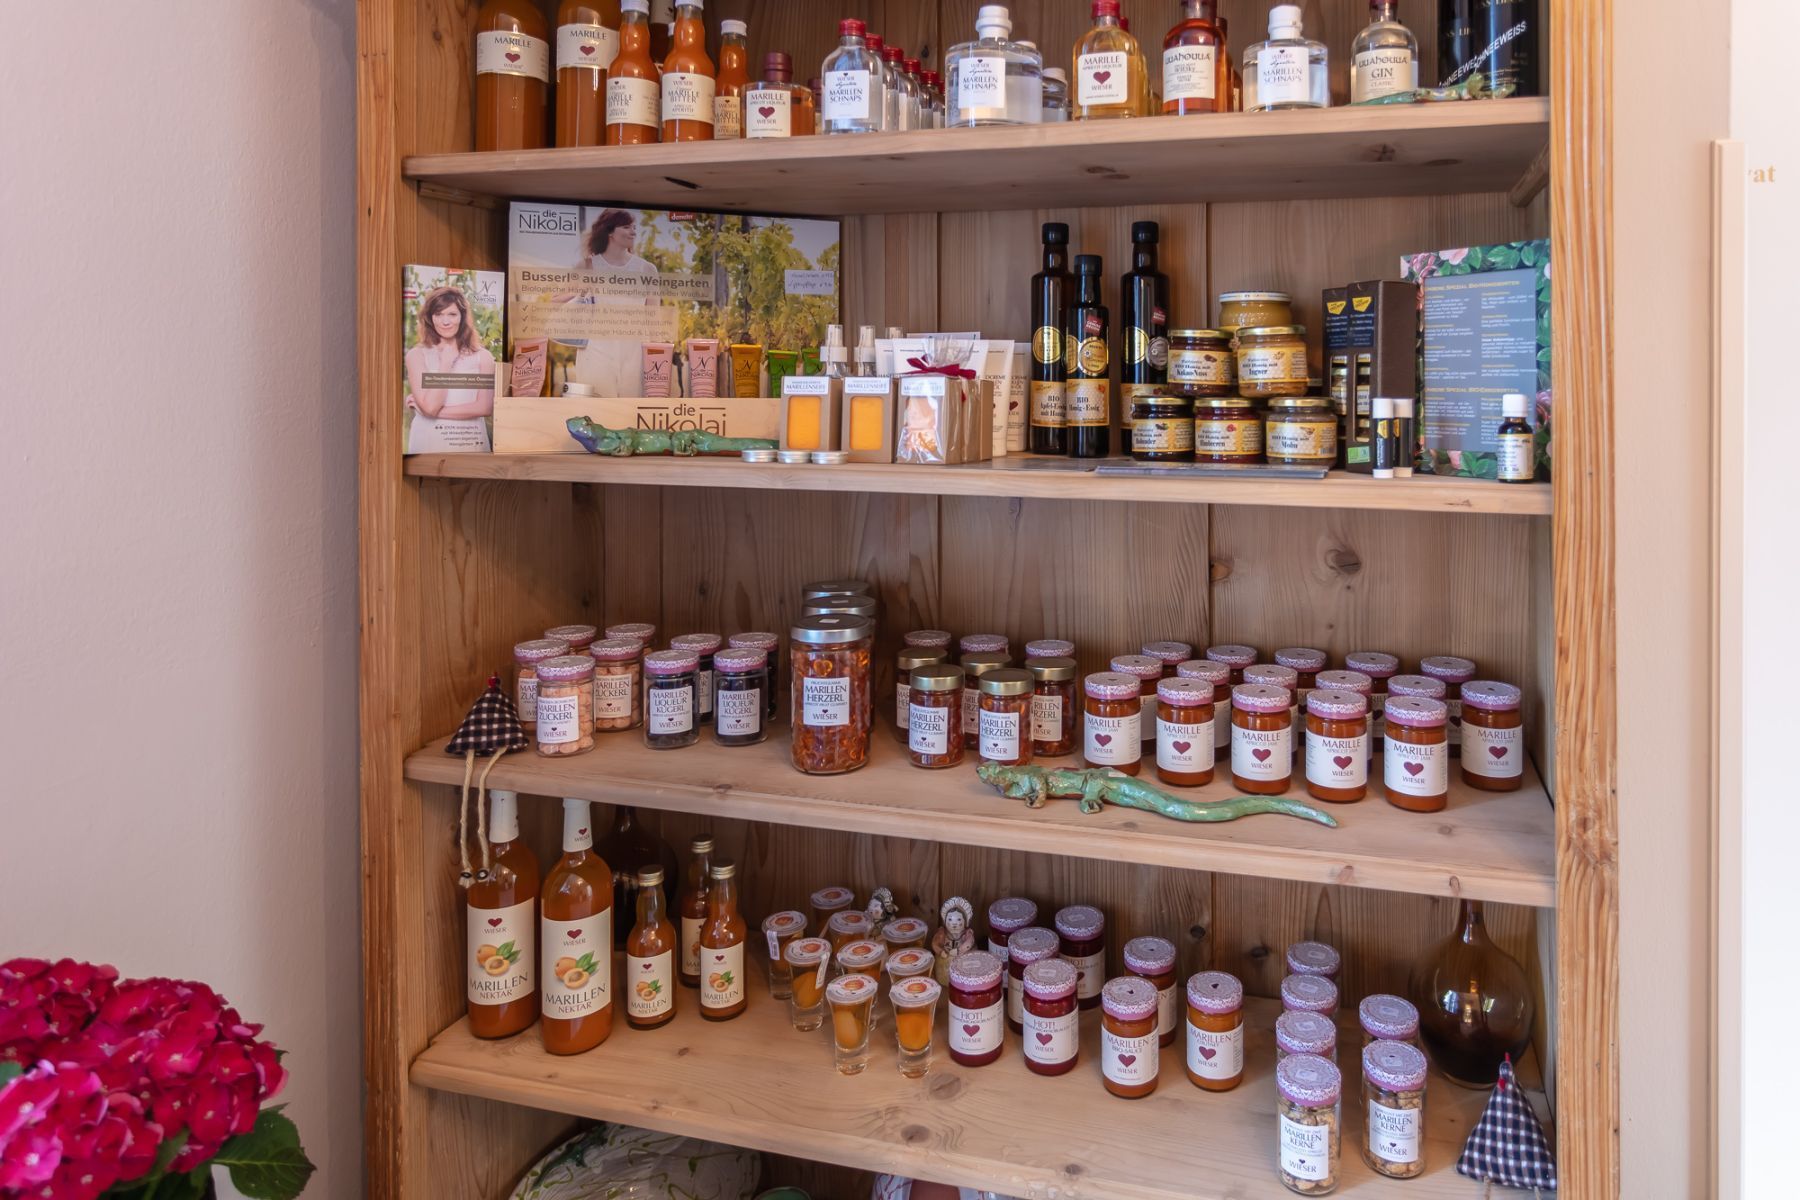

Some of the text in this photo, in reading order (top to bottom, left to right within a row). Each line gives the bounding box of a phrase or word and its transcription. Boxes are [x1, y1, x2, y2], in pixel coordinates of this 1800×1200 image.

[570, 30, 607, 40] MARILLE
[494, 37, 532, 48] MARILLE
[1084, 55, 1120, 65] MARILLE
[1263, 67, 1303, 76] MARILLEN
[1371, 67, 1393, 79] GIN
[963, 76, 998, 84] MARILLEN
[1264, 74, 1302, 83] SCHNAPS
[963, 83, 998, 91] SCHNAPS
[668, 90, 700, 98] MARILLE
[750, 92, 784, 100] MARILLE
[829, 88, 863, 97] MARILLEN
[670, 96, 697, 104] BITTER
[830, 95, 863, 103] SCHNAPS
[542, 209, 557, 218] die
[519, 213, 577, 232] Nikolai
[582, 275, 605, 285] aus
[609, 274, 637, 286] dem
[673, 404, 696, 416] die
[805, 684, 847, 694] MARILLEN
[653, 690, 689, 699] MARILLEN
[721, 692, 756, 700] MARILLEN
[807, 693, 845, 703] HERZERL
[538, 702, 575, 712] MARILLEN
[654, 698, 687, 706] LIQUEUR
[723, 699, 755, 708] LIQUEUR
[656, 705, 685, 713] KUGERL
[724, 706, 752, 714] KUGERL
[539, 711, 573, 720] ZUCKERL
[911, 711, 945, 723] MARILLEN
[659, 720, 684, 728] WIESER
[727, 722, 751, 730] WIESER
[911, 720, 943, 731] HERZERL
[981, 717, 1017, 728] MARILLEN
[1087, 717, 1122, 728] MARILLE
[981, 727, 1014, 738] HERZERL
[1163, 724, 1201, 735] MARILLE
[1477, 729, 1517, 739] MARILLE
[1242, 731, 1281, 742] MARILLE
[913, 739, 935, 748] WIESER
[1322, 738, 1361, 749] MARILLE
[985, 745, 1008, 754] WIESER
[1393, 743, 1435, 756] MARILLE
[1402, 776, 1425, 784] WIESER
[484, 926, 507, 934] WIESER
[563, 938, 586, 947] WIESER
[470, 971, 529, 992] MARILLEN
[480, 988, 513, 1000] NEKTAR
[545, 983, 607, 1006] MARILLEN
[704, 990, 739, 1001] MARILLEN
[558, 1001, 592, 1014] NEKTAR
[631, 998, 667, 1010] MARILLEN
[960, 1011, 984, 1021] HOT!
[1033, 1019, 1056, 1029] HOT!
[961, 1036, 982, 1044] WIESER
[1190, 1027, 1232, 1043] MARILLEN
[1106, 1034, 1149, 1048] MARILLEN
[1197, 1058, 1218, 1068] WIESER
[1375, 1110, 1413, 1124] MARILLEN
[1380, 1121, 1406, 1132] KERNE
[1285, 1126, 1322, 1142] MARILLEN
[1290, 1137, 1315, 1150] KERNE
[1379, 1142, 1408, 1156] WIESER
[1289, 1160, 1317, 1173] WIESER
